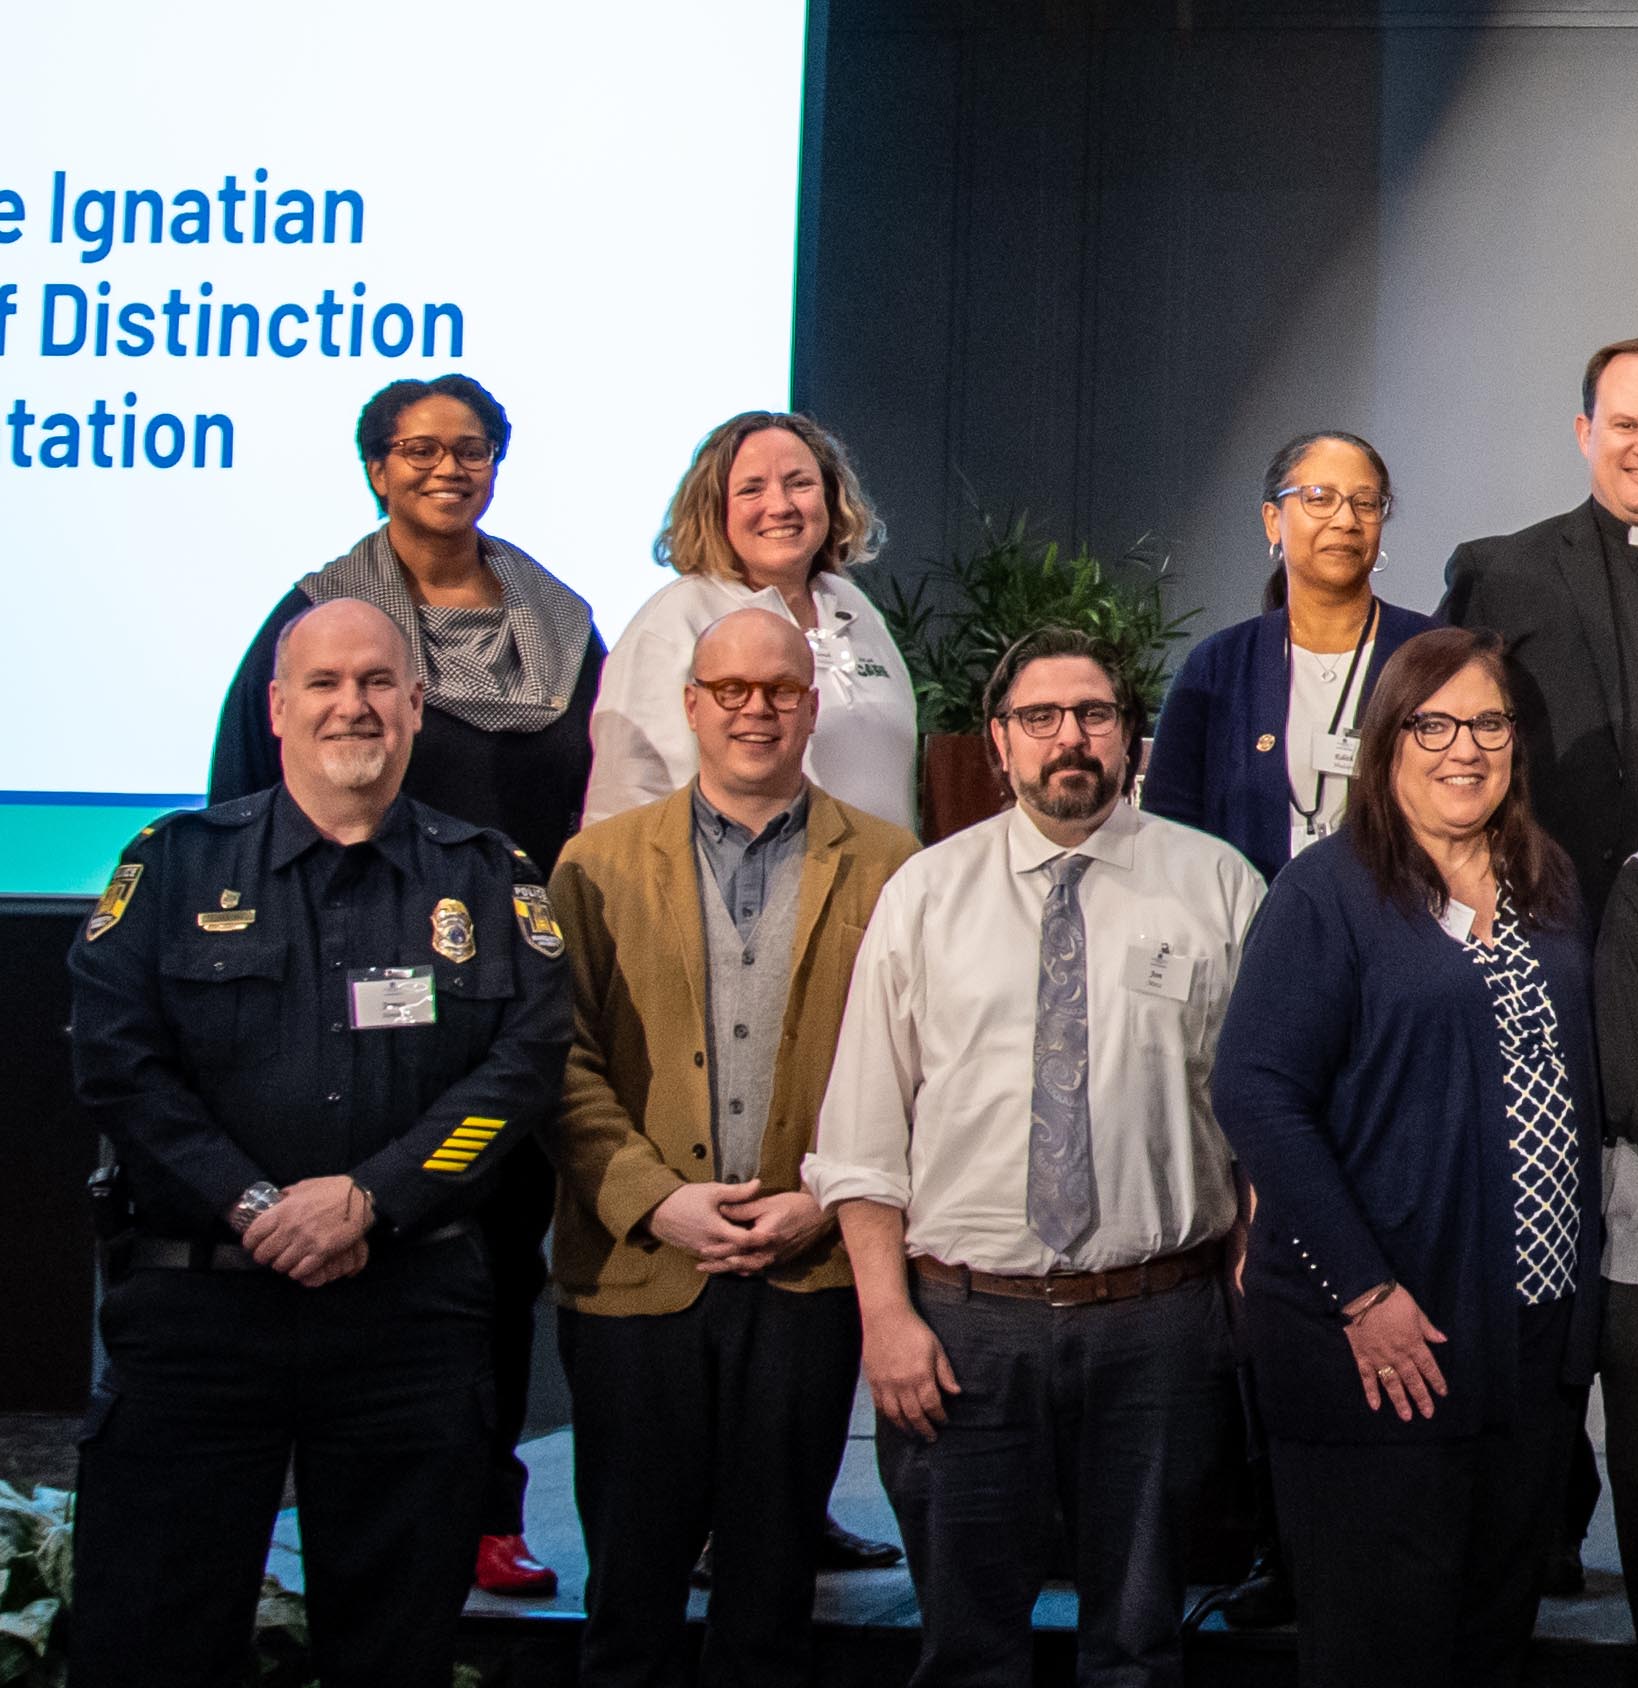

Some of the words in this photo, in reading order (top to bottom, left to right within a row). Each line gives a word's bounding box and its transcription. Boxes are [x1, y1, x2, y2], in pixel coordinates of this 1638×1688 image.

[0, 189, 26, 244] e
[50, 167, 366, 264] Ignatian
[0, 283, 18, 357] f
[40, 281, 466, 358] Distinction
[5, 391, 235, 468] tation
